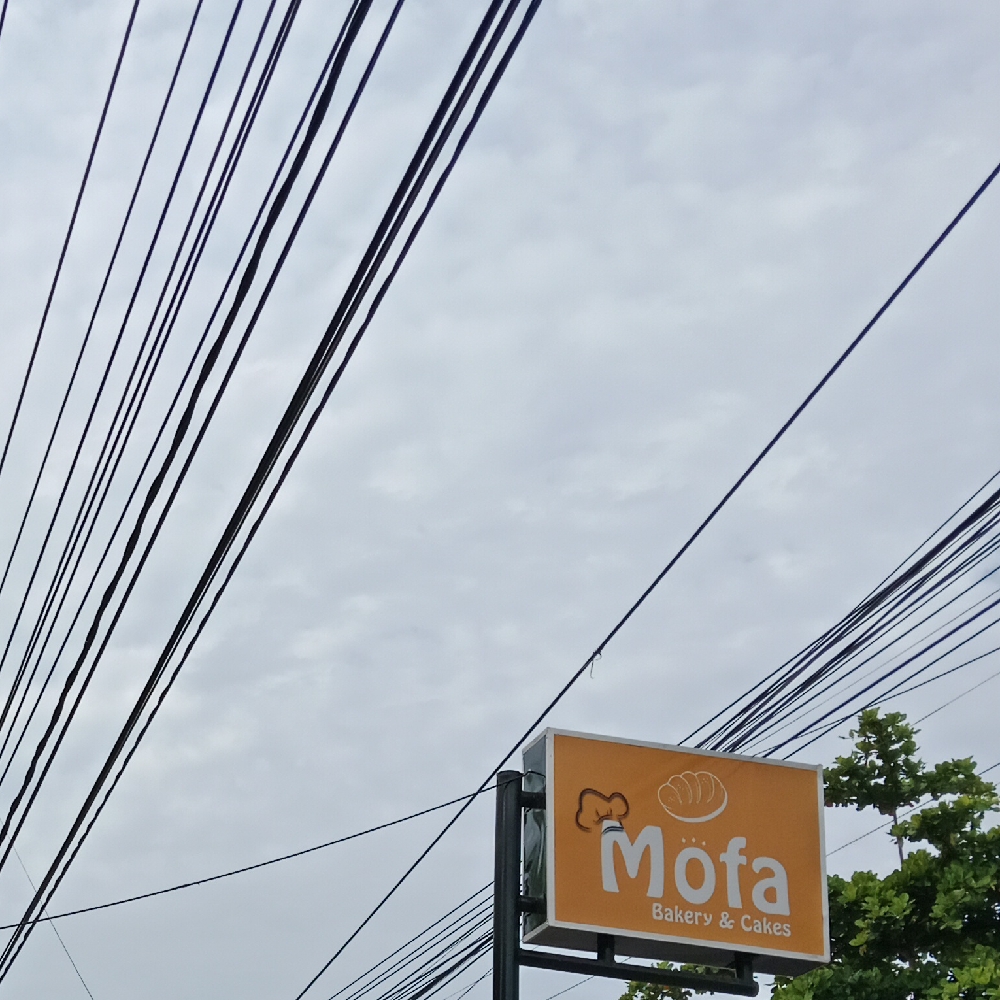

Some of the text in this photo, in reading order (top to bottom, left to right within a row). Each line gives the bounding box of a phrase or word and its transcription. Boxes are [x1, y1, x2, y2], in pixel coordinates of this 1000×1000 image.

[600, 819, 790, 916] Mofa
[652, 902, 792, 938] Bakery & Cakes
